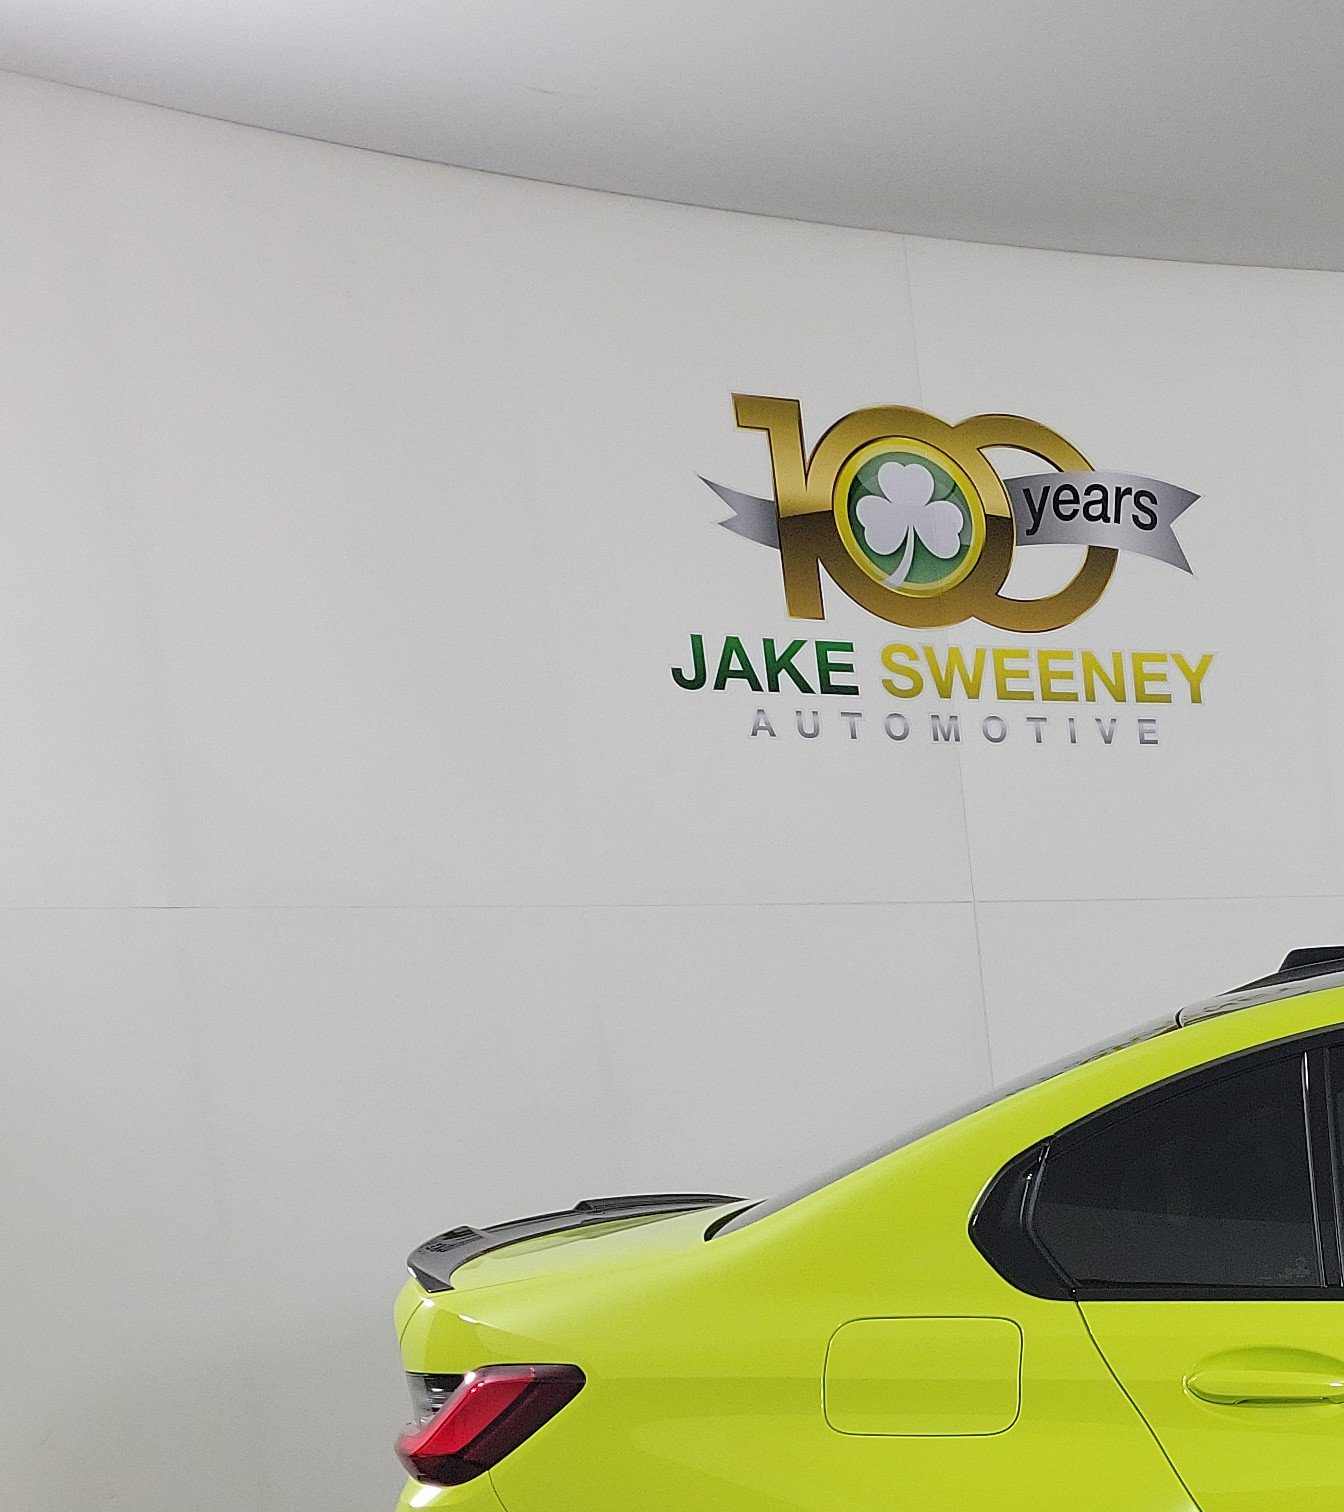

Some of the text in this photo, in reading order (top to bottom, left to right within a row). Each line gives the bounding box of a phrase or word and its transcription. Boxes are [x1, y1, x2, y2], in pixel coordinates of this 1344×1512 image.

[731, 392, 1158, 633] 100 years
[671, 634, 1214, 703] JAKE SWEENEY
[750, 708, 1159, 745] AUTOMOTIVE
